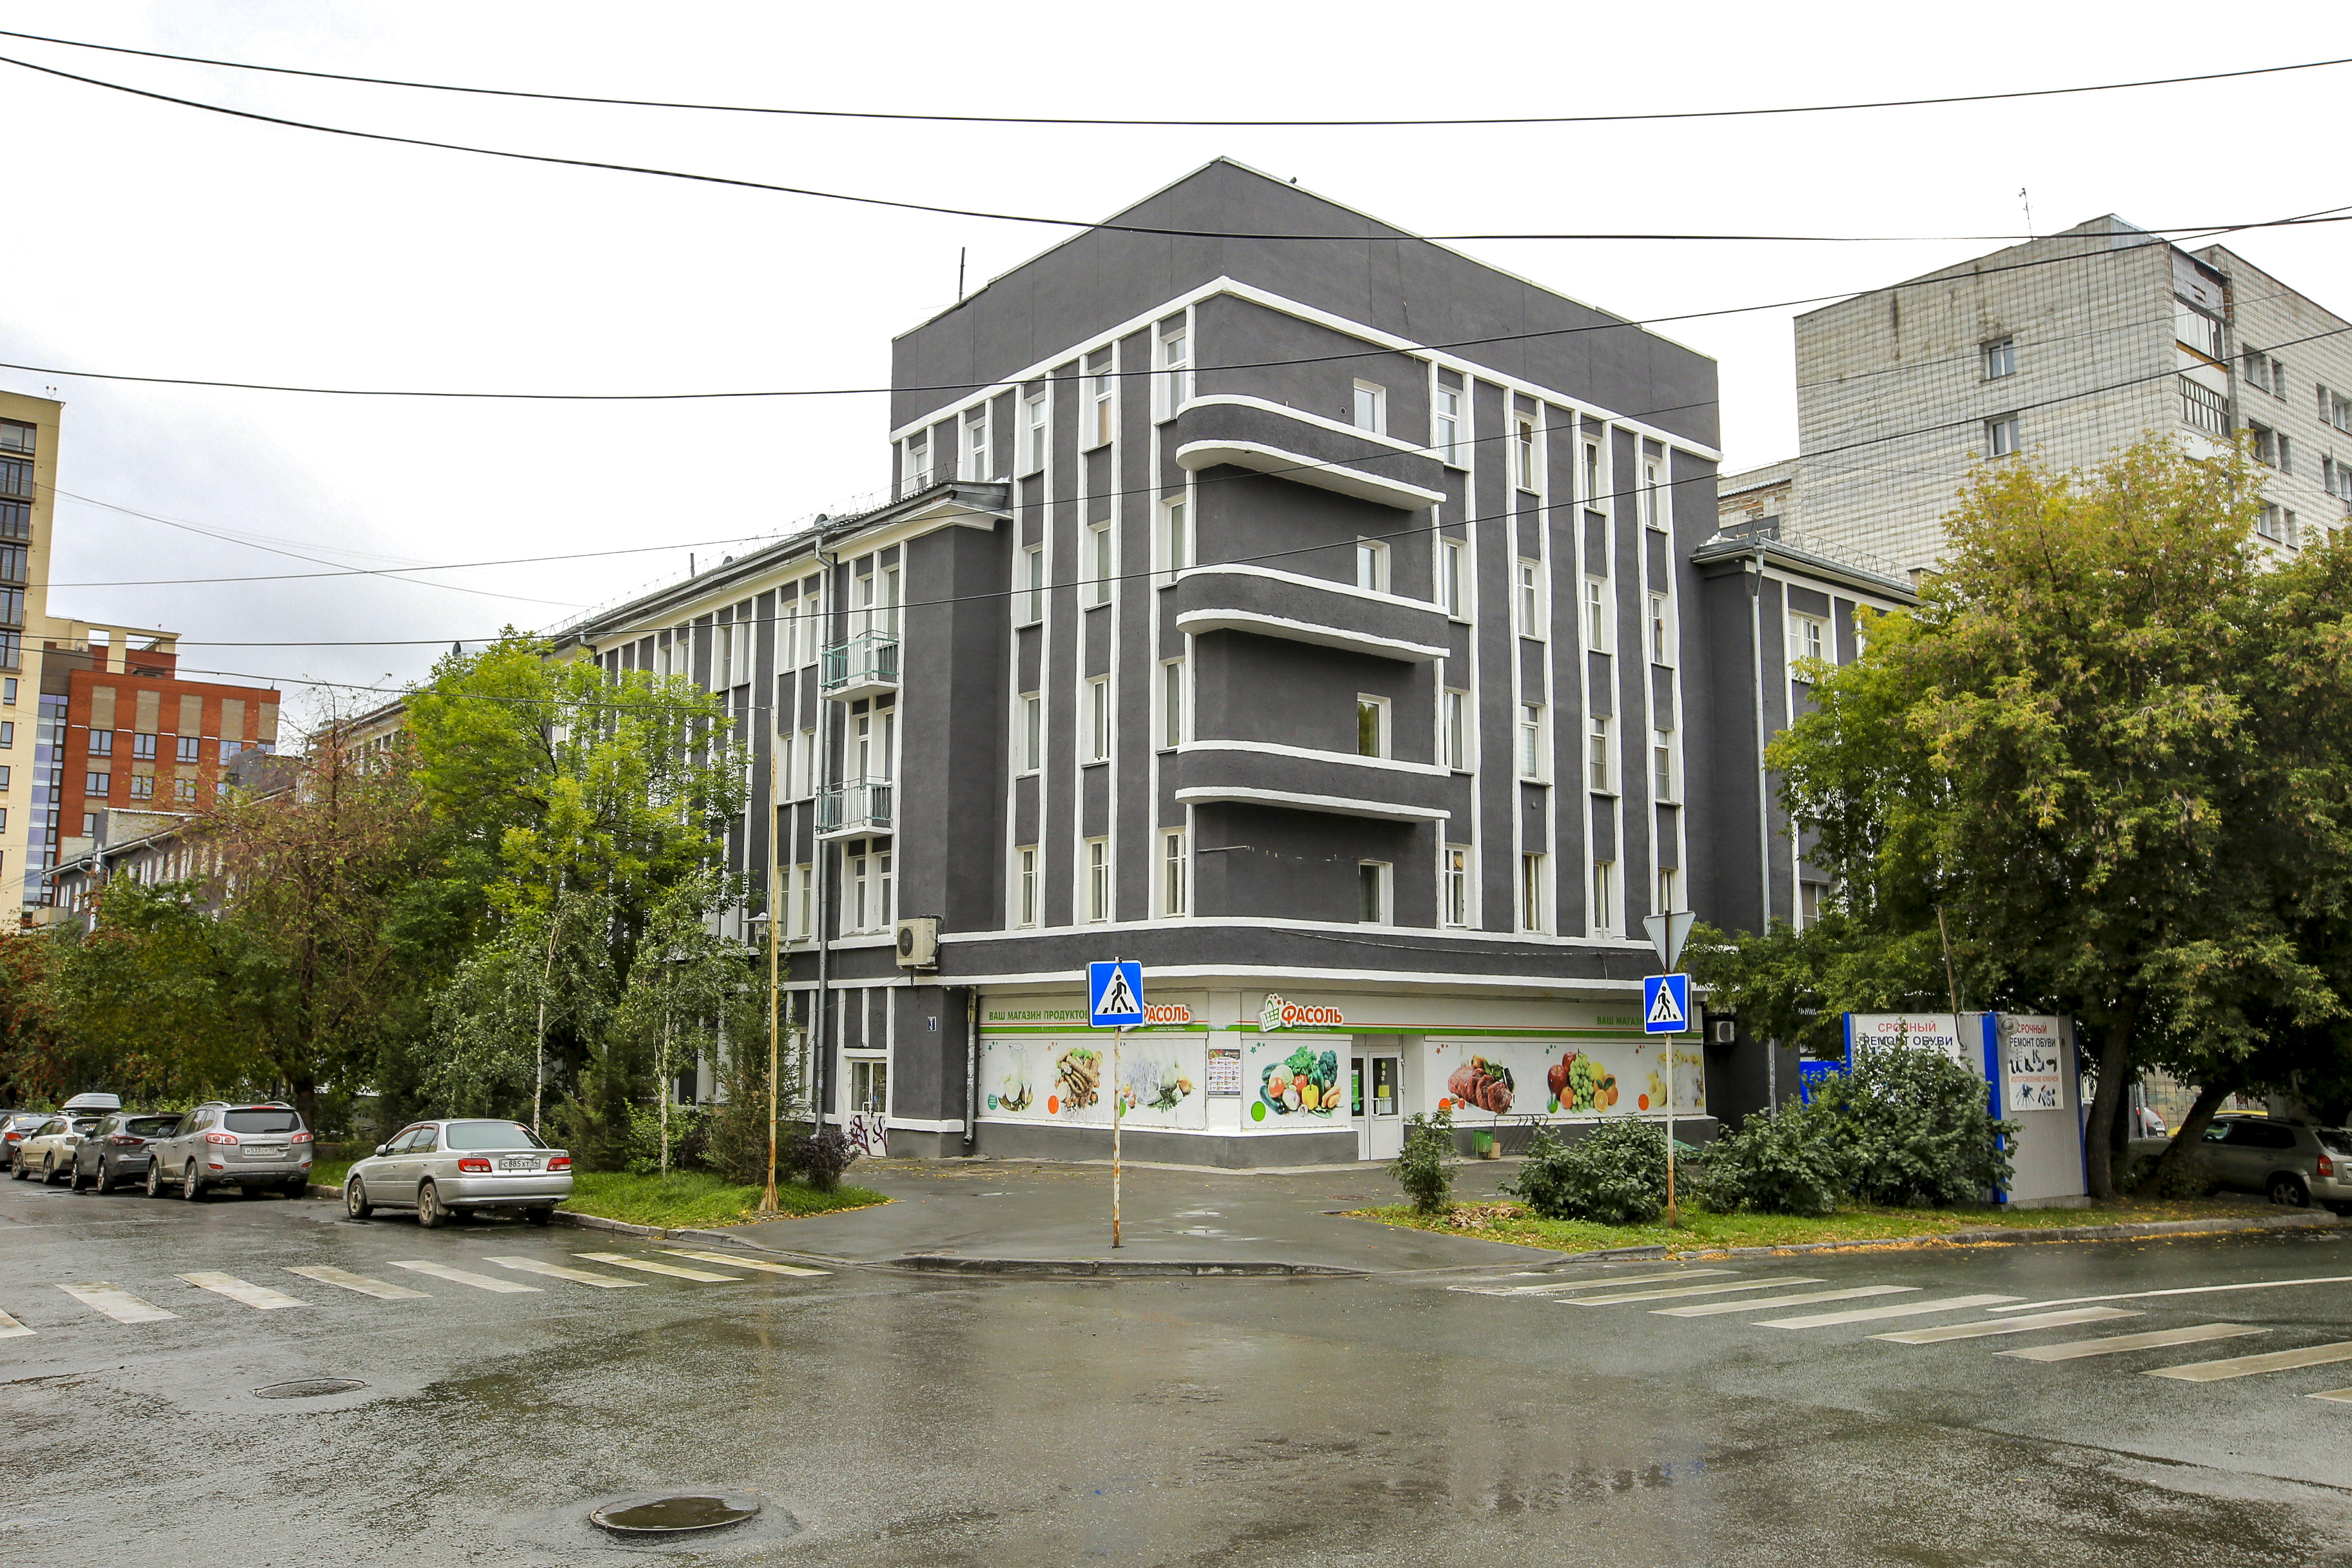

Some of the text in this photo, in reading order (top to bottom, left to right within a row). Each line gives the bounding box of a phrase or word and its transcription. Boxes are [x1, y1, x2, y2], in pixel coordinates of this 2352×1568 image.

[989, 1012, 1005, 1020] ВАШ
[1007, 1011, 1041, 1020] МАГАЗИН
[1282, 1005, 1342, 1024] ФАСОЛЬ
[1597, 1017, 1614, 1025] ВАШ
[2017, 1023, 2047, 1034] СРОЧНЫЙ
[1913, 1036, 1953, 1046] ОБУВИ
[2010, 1037, 2056, 1047] РЕМОНТ ОБУВИ
